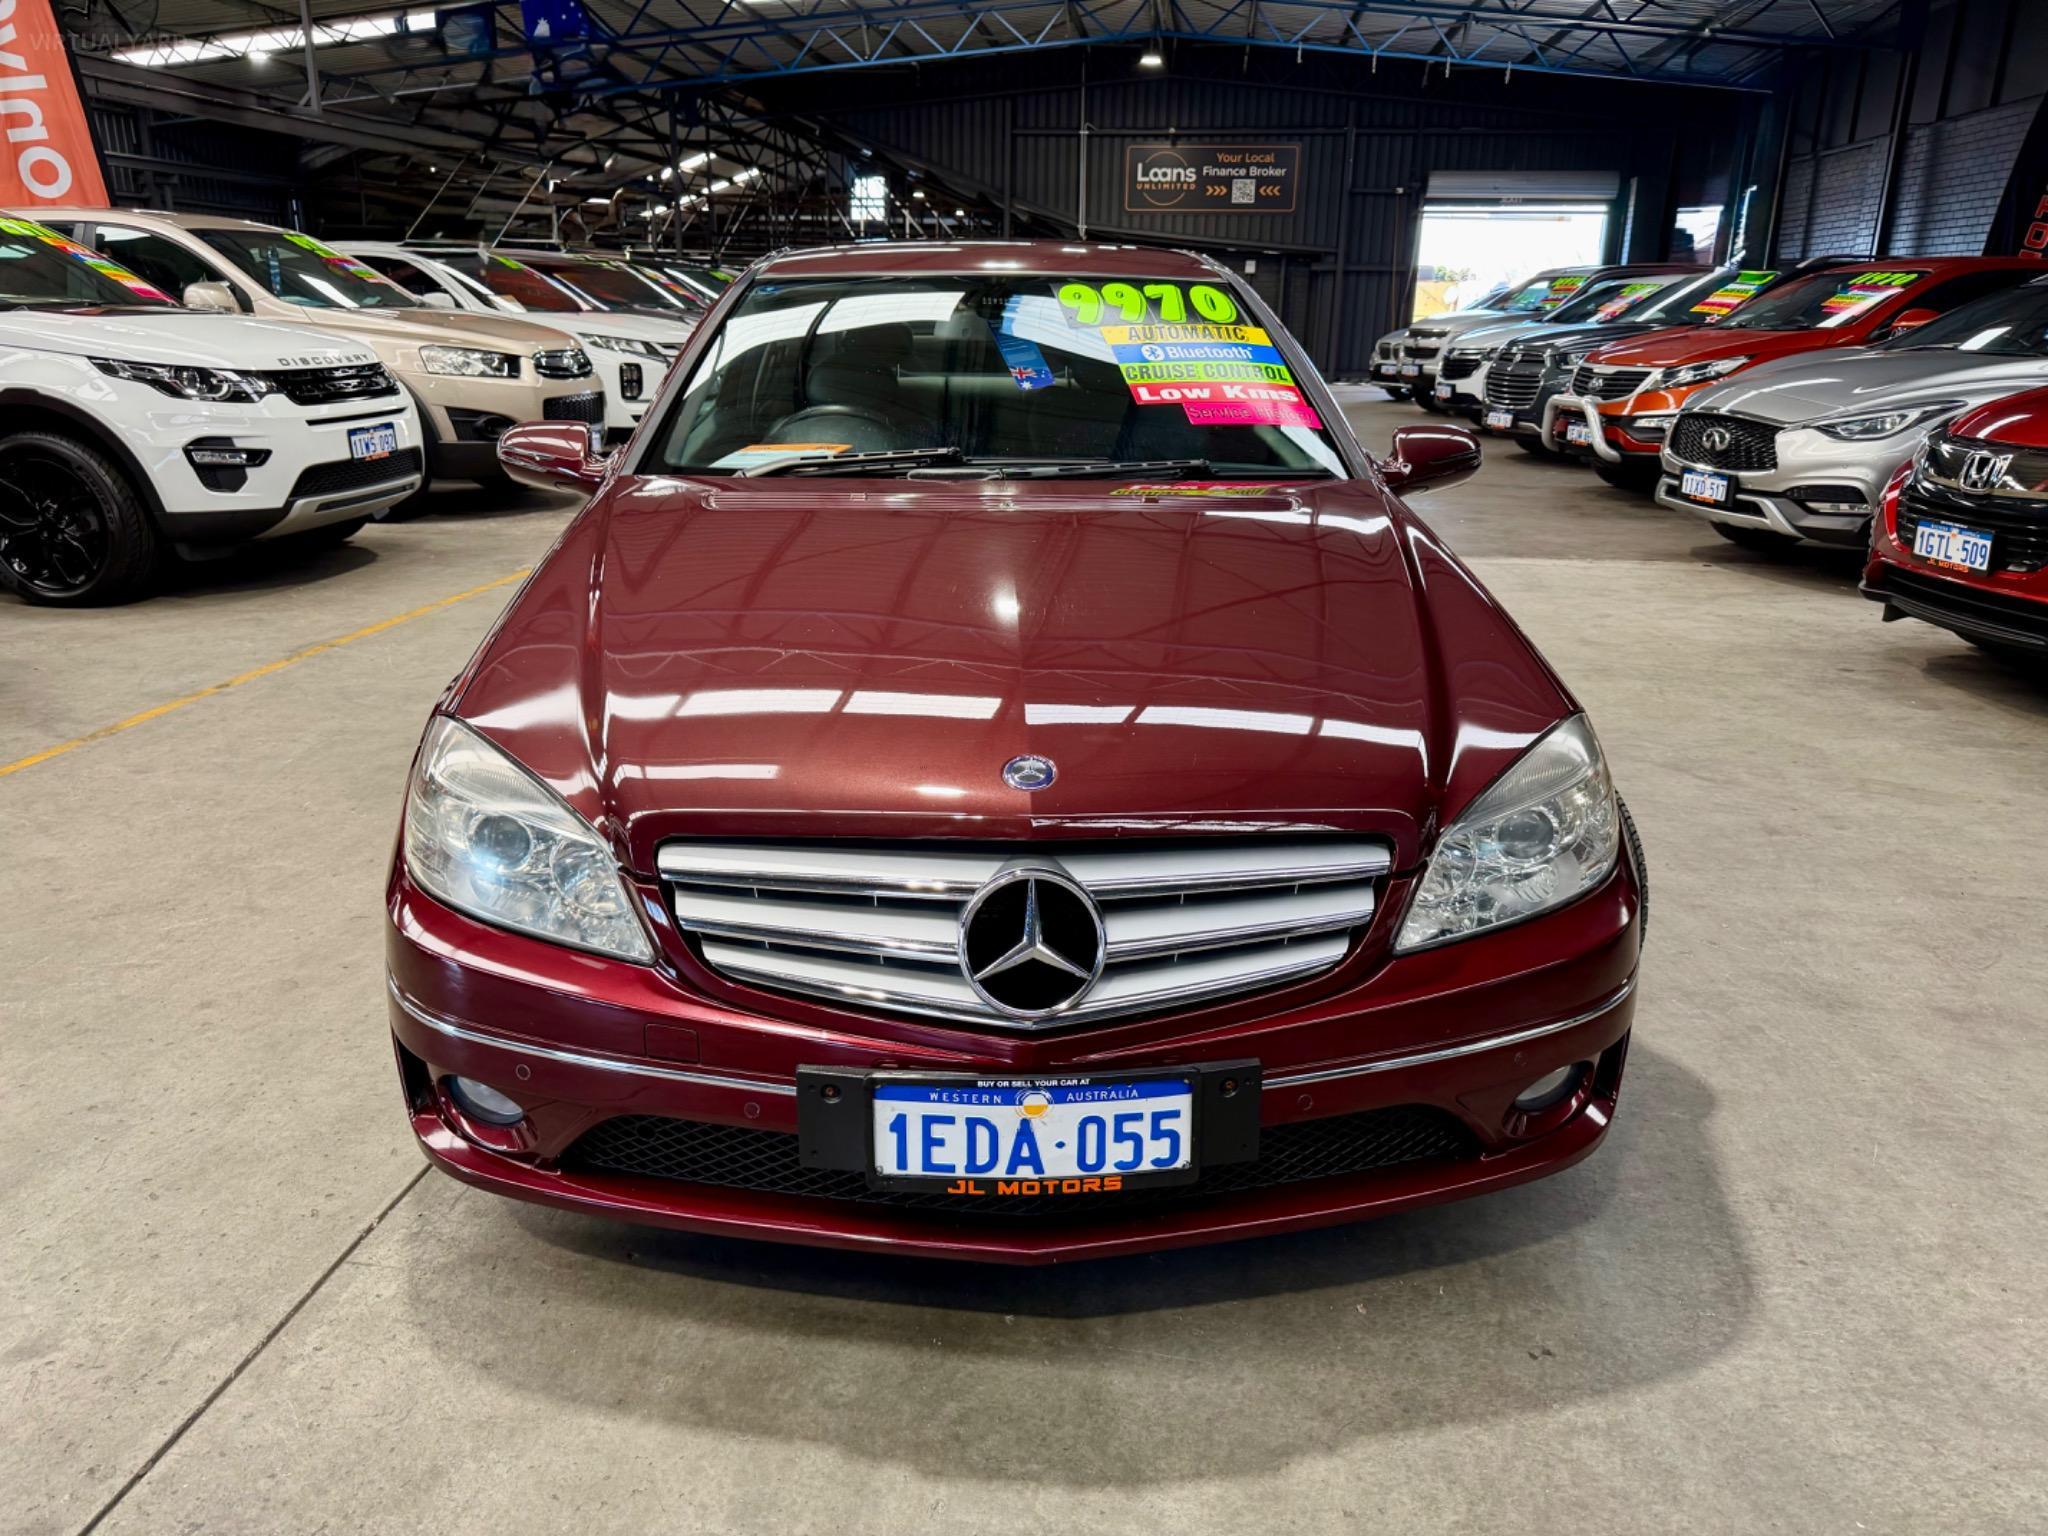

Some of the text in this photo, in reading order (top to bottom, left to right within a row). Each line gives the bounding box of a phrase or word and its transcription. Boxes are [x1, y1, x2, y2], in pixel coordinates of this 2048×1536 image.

[1216, 152, 1275, 163] Your Local
[1136, 162, 1197, 182] Loans
[1202, 165, 1287, 177] Finance Broker
[1136, 182, 1197, 190] UNLIMITED
[1058, 283, 1238, 324] 9970
[1128, 326, 1246, 341] AUTOMATIC
[1165, 345, 1252, 359] Bluetooth
[277, 354, 368, 366] DISCOVERY
[1126, 364, 1288, 381] CRUISE CONTROL
[1137, 385, 1299, 402] Low Kms
[1188, 405, 1252, 418] Service
[977, 1080, 994, 1088] BUY
[996, 1080, 1009, 1088] OR
[1011, 1080, 1033, 1088] SELL
[1034, 1079, 1058, 1087] YOUR
[929, 1089, 1139, 1104] WESTERN AUSTRALIA
[947, 1176, 1123, 1196] JL MOTORS
